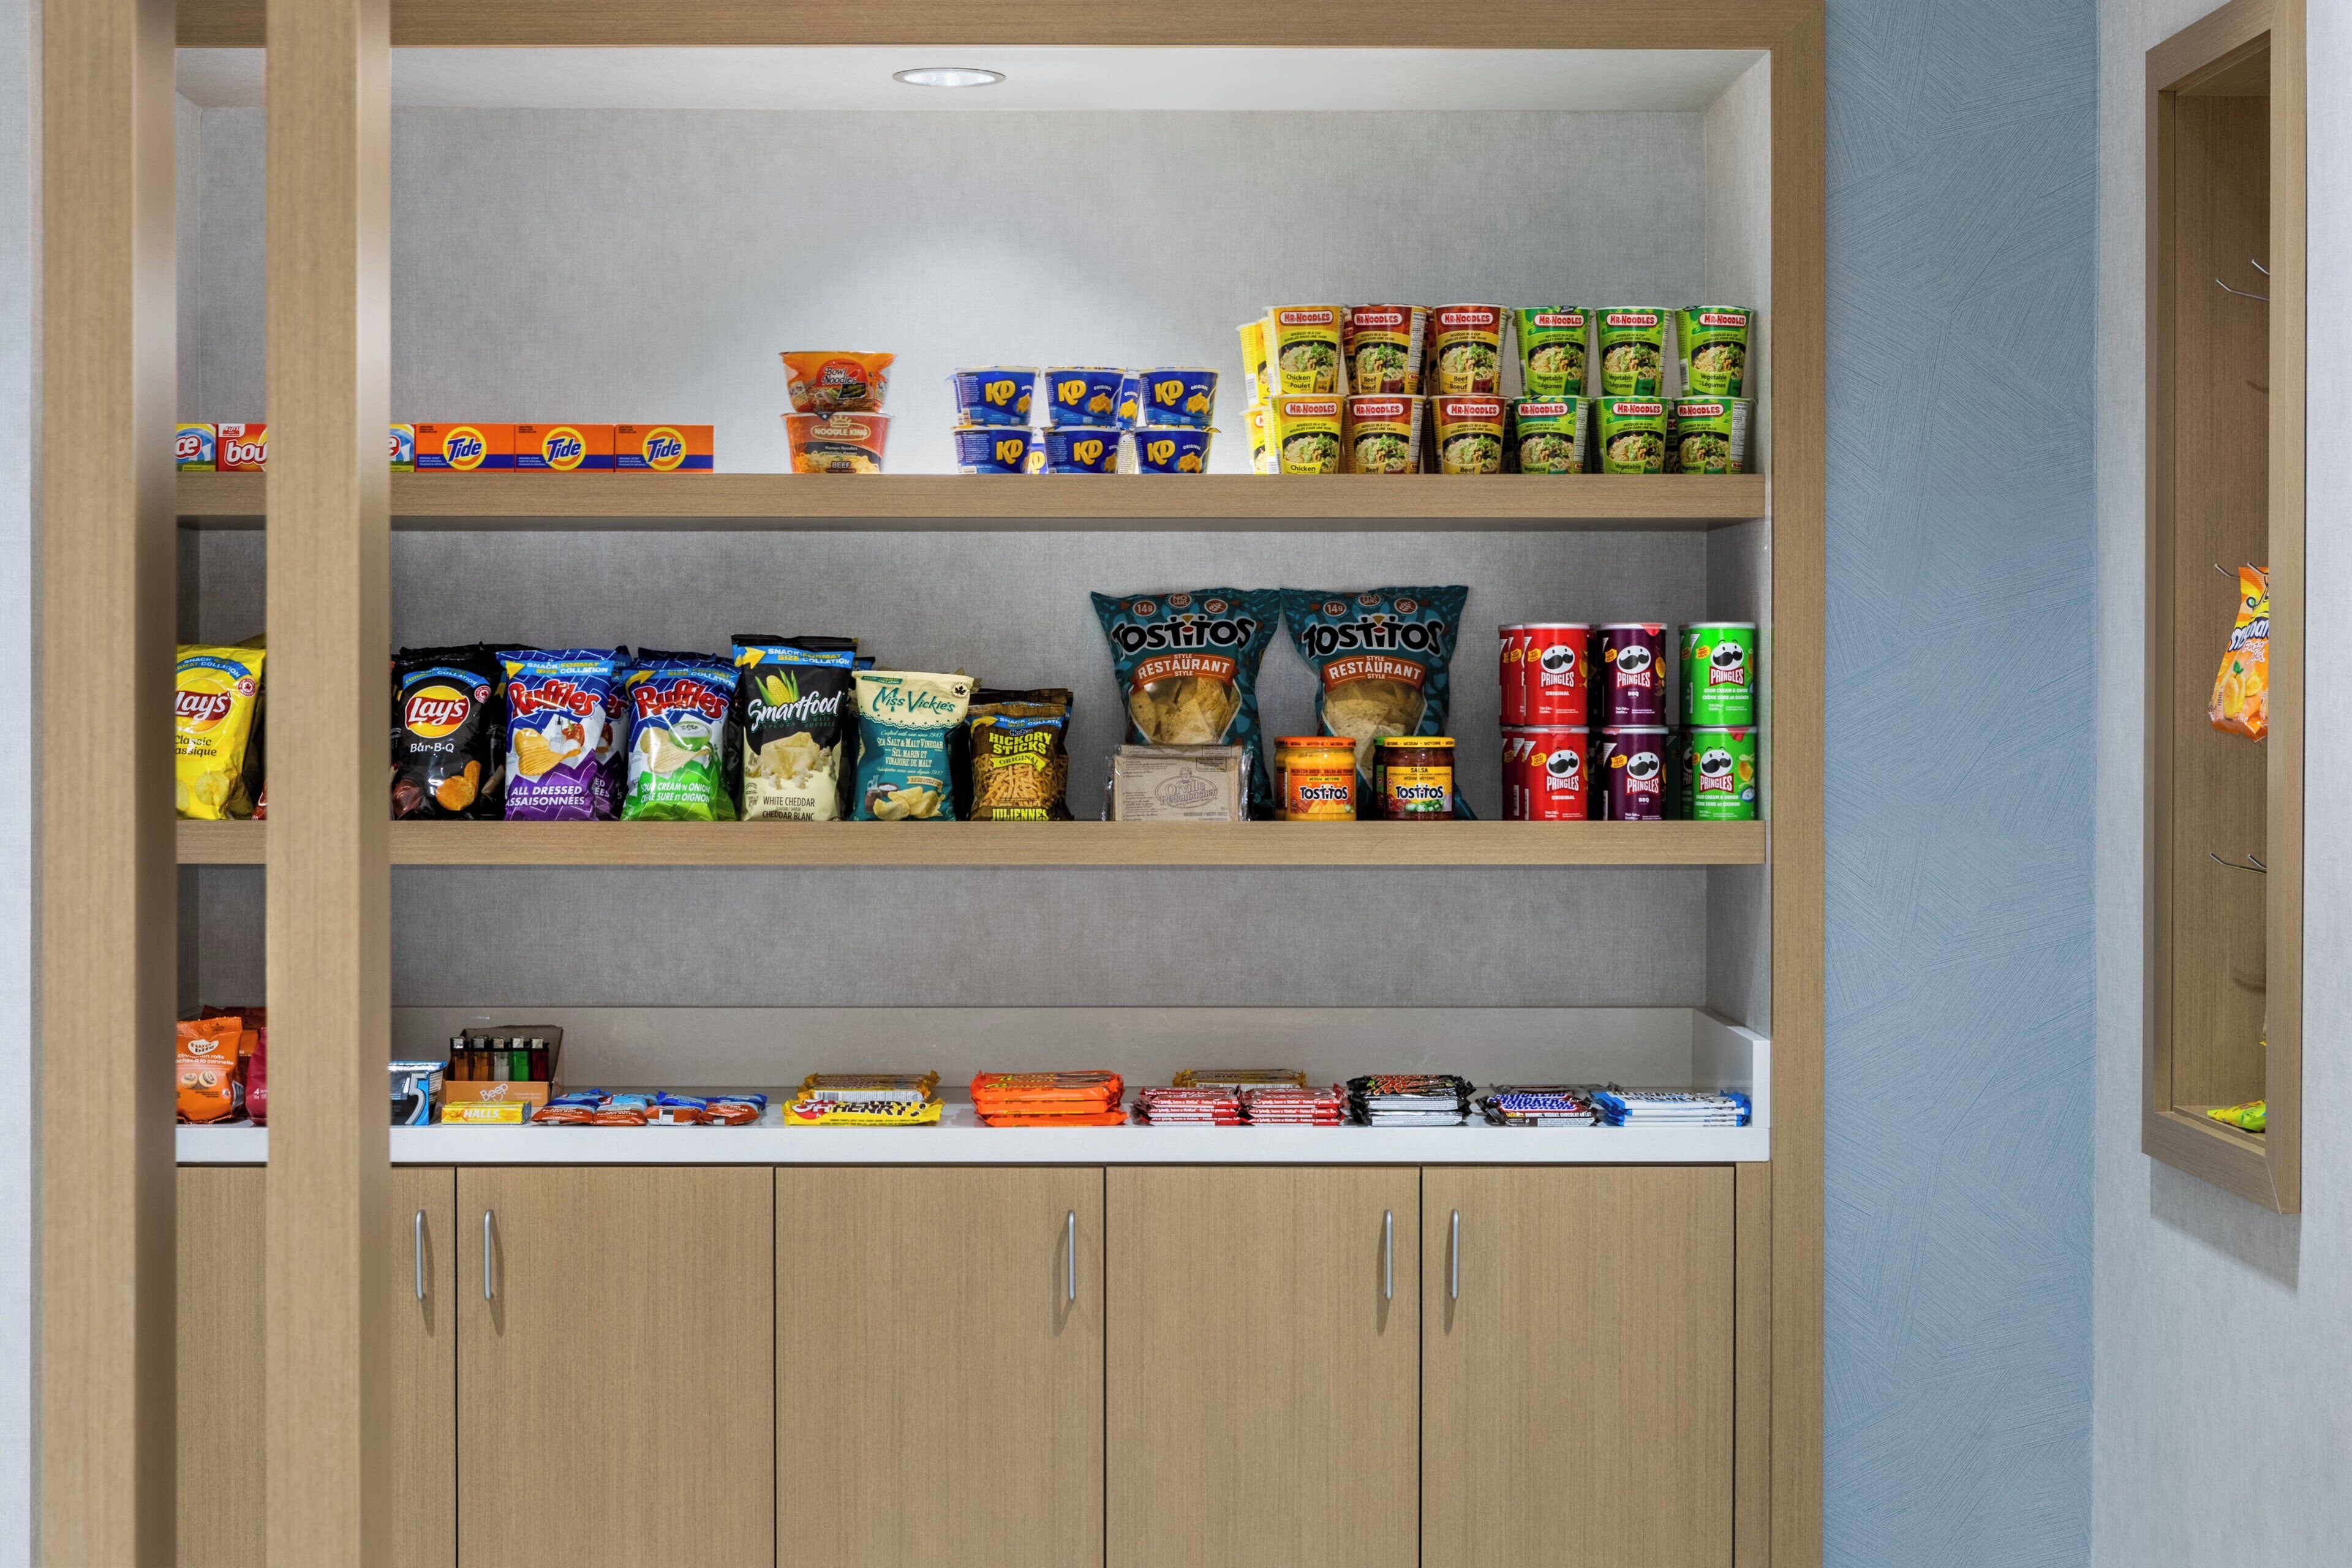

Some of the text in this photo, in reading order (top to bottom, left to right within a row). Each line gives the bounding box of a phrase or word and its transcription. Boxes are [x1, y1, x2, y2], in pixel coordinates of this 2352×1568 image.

[824, 366, 847, 376] Bowl
[822, 375, 857, 385] Noodles
[447, 437, 482, 463] Tide
[546, 437, 582, 463] Tide
[646, 437, 682, 464] Tide
[1137, 604, 1153, 612] 14g
[1327, 604, 1343, 612] 14g
[201, 660, 241, 677] COLLATION
[1138, 658, 1230, 680] RESTAURANT
[1329, 661, 1422, 680] RESTAURANT
[1711, 668, 1744, 685] PRINGLES
[437, 671, 478, 685] COLLATION
[691, 671, 736, 688] COLLATION
[1541, 671, 1574, 687] PRINGLES
[1617, 671, 1650, 688] PRINGLES
[176, 692, 228, 722] Lay's
[508, 679, 601, 718] Ruffles
[633, 680, 729, 720] Ruffles
[872, 686, 956, 715] Miss Vickie's
[407, 698, 466, 726] Lay's
[748, 690, 842, 733] Smartfood
[876, 737, 886, 747] SEA
[886, 737, 900, 747] SALT
[905, 738, 920, 748] MALT
[921, 739, 943, 749] VINEGAR
[989, 731, 1052, 747] HICKORY
[892, 747, 927, 759] SEL MARIN ET
[992, 742, 1047, 755] STICKS
[885, 756, 910, 767] VINAIGRE
[918, 760, 932, 768] MALT
[999, 755, 1039, 768] ORIGINAL
[511, 786, 530, 796] ALL
[532, 786, 582, 796] DRESSED
[688, 782, 710, 794] ONION
[1165, 780, 1205, 796] Orville
[1547, 775, 1579, 792] PRINGLES
[1627, 777, 1659, 794] PRINGLES
[1700, 774, 1733, 791] PRINGLES
[657, 793, 674, 801] SURE
[682, 793, 710, 803] OIGNON
[763, 796, 815, 807] WHITE CHEDDAR
[1160, 788, 1216, 806] Redenbacher
[763, 810, 815, 821] CHEDDAR BLANC
[991, 808, 1049, 821] JULIENNES
[405, 1073, 428, 1125] 5
[480, 1083, 508, 1101] Beep
[464, 1109, 500, 1118] HALLS
